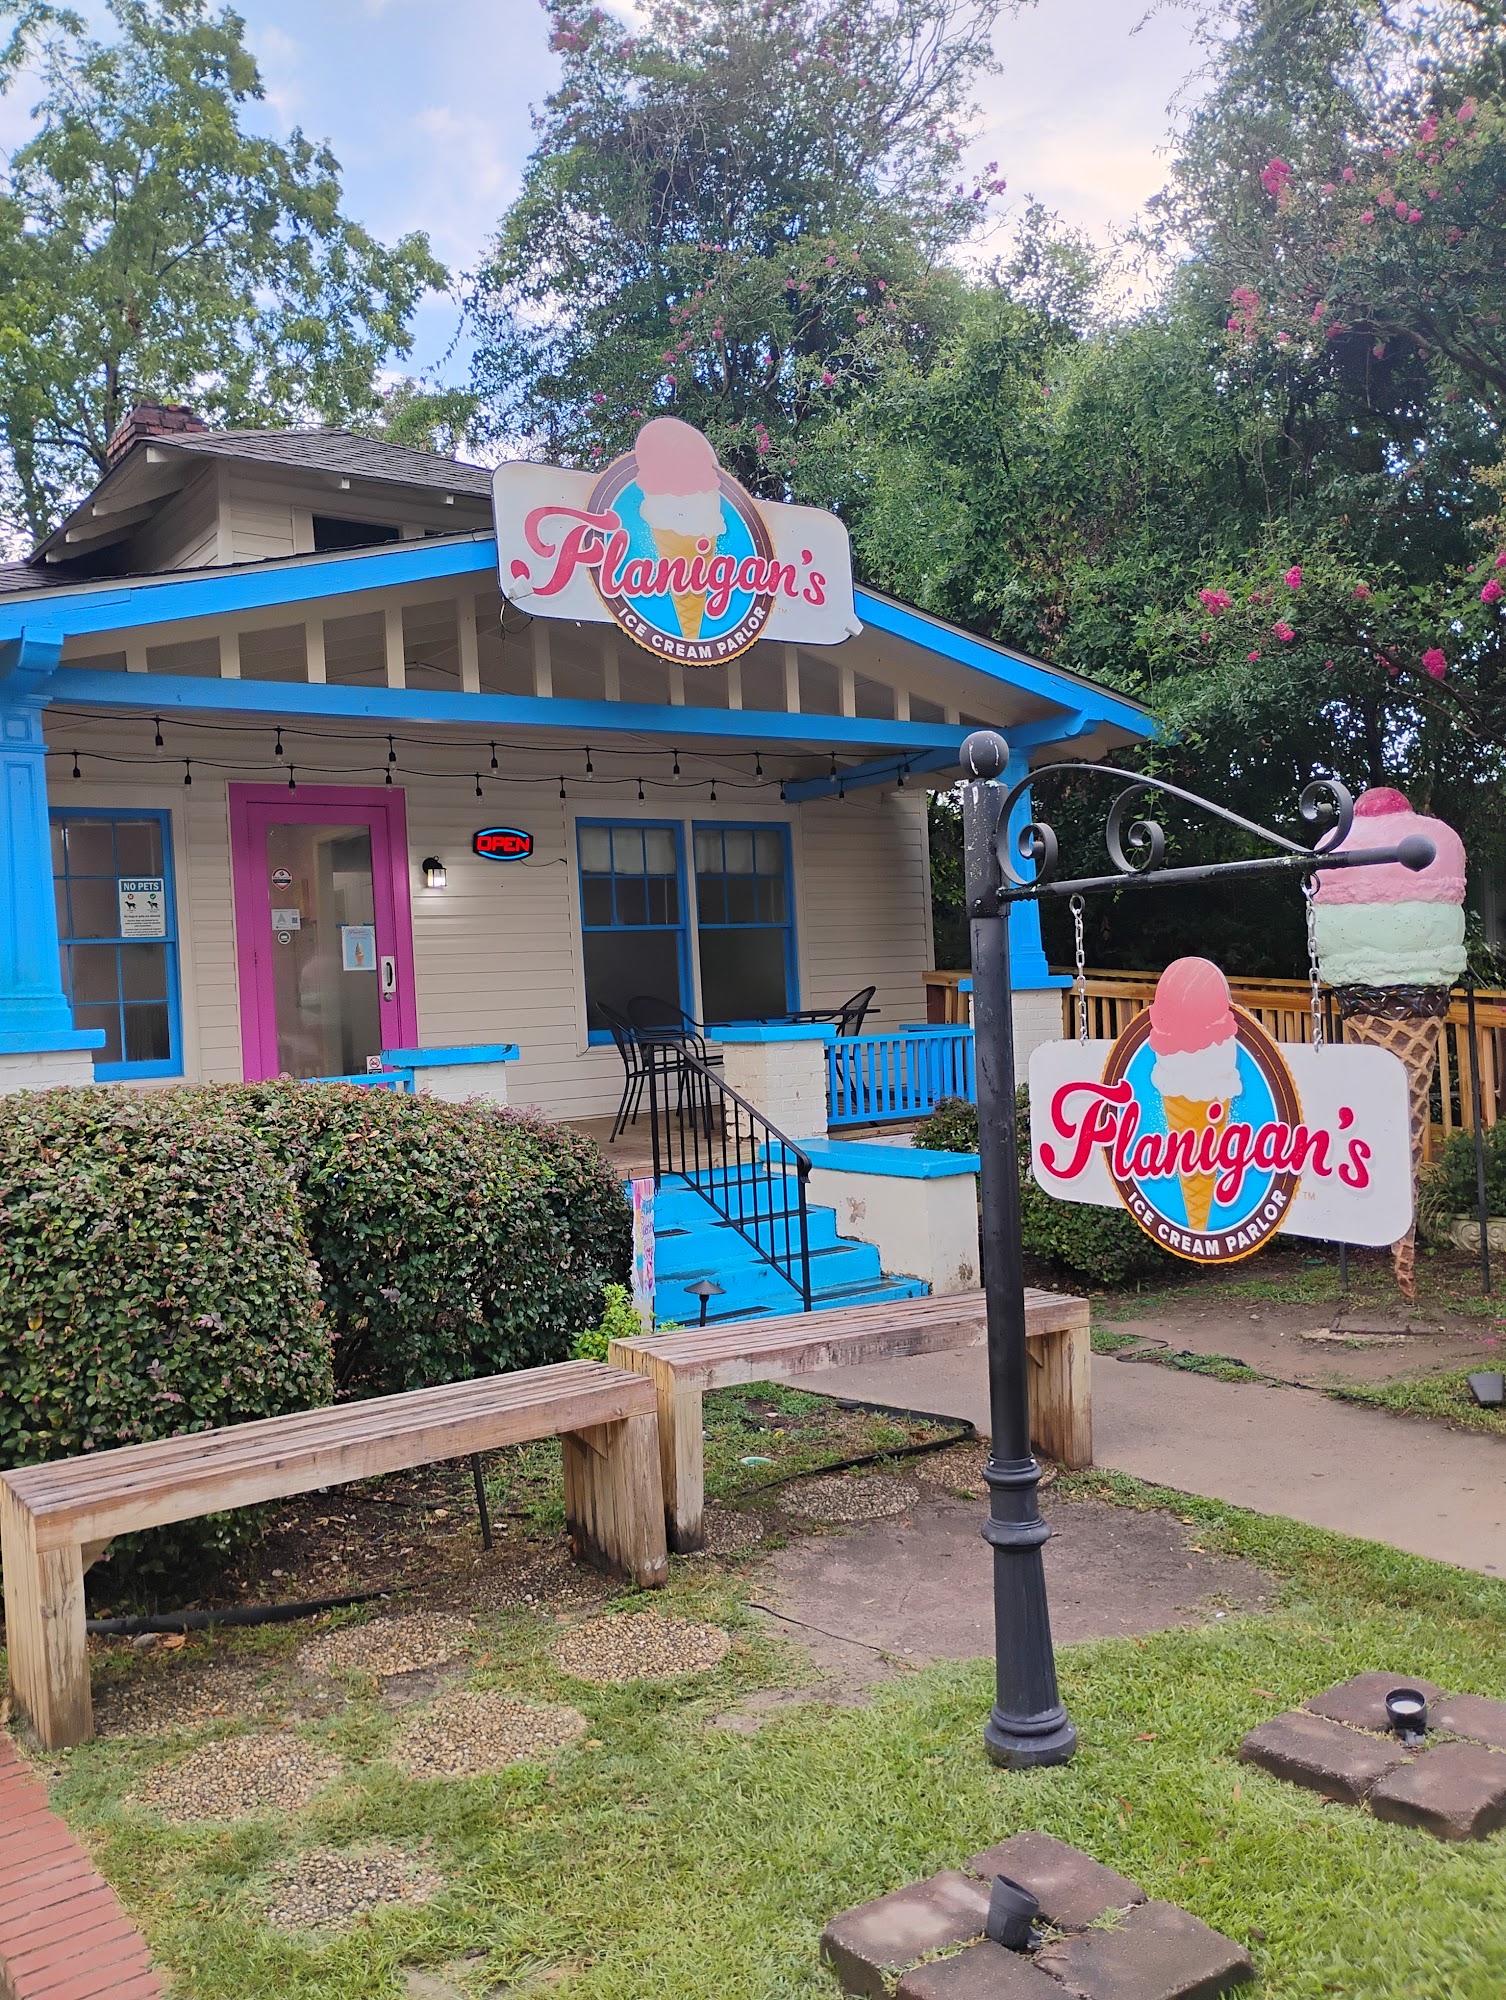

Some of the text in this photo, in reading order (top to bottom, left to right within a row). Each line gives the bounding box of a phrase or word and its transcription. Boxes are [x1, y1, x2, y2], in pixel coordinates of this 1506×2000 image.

[510, 506, 826, 618] Flanigan's
[618, 606, 766, 659] ICE CREAM PARLOR
[477, 836, 530, 852] OPEN
[123, 882, 159, 891] NO PETS
[1039, 1080, 1371, 1205] Flanigan's
[1302, 1191, 1316, 1200] TM
[1128, 1189, 1287, 1256] ICE CREAM PARLOR
